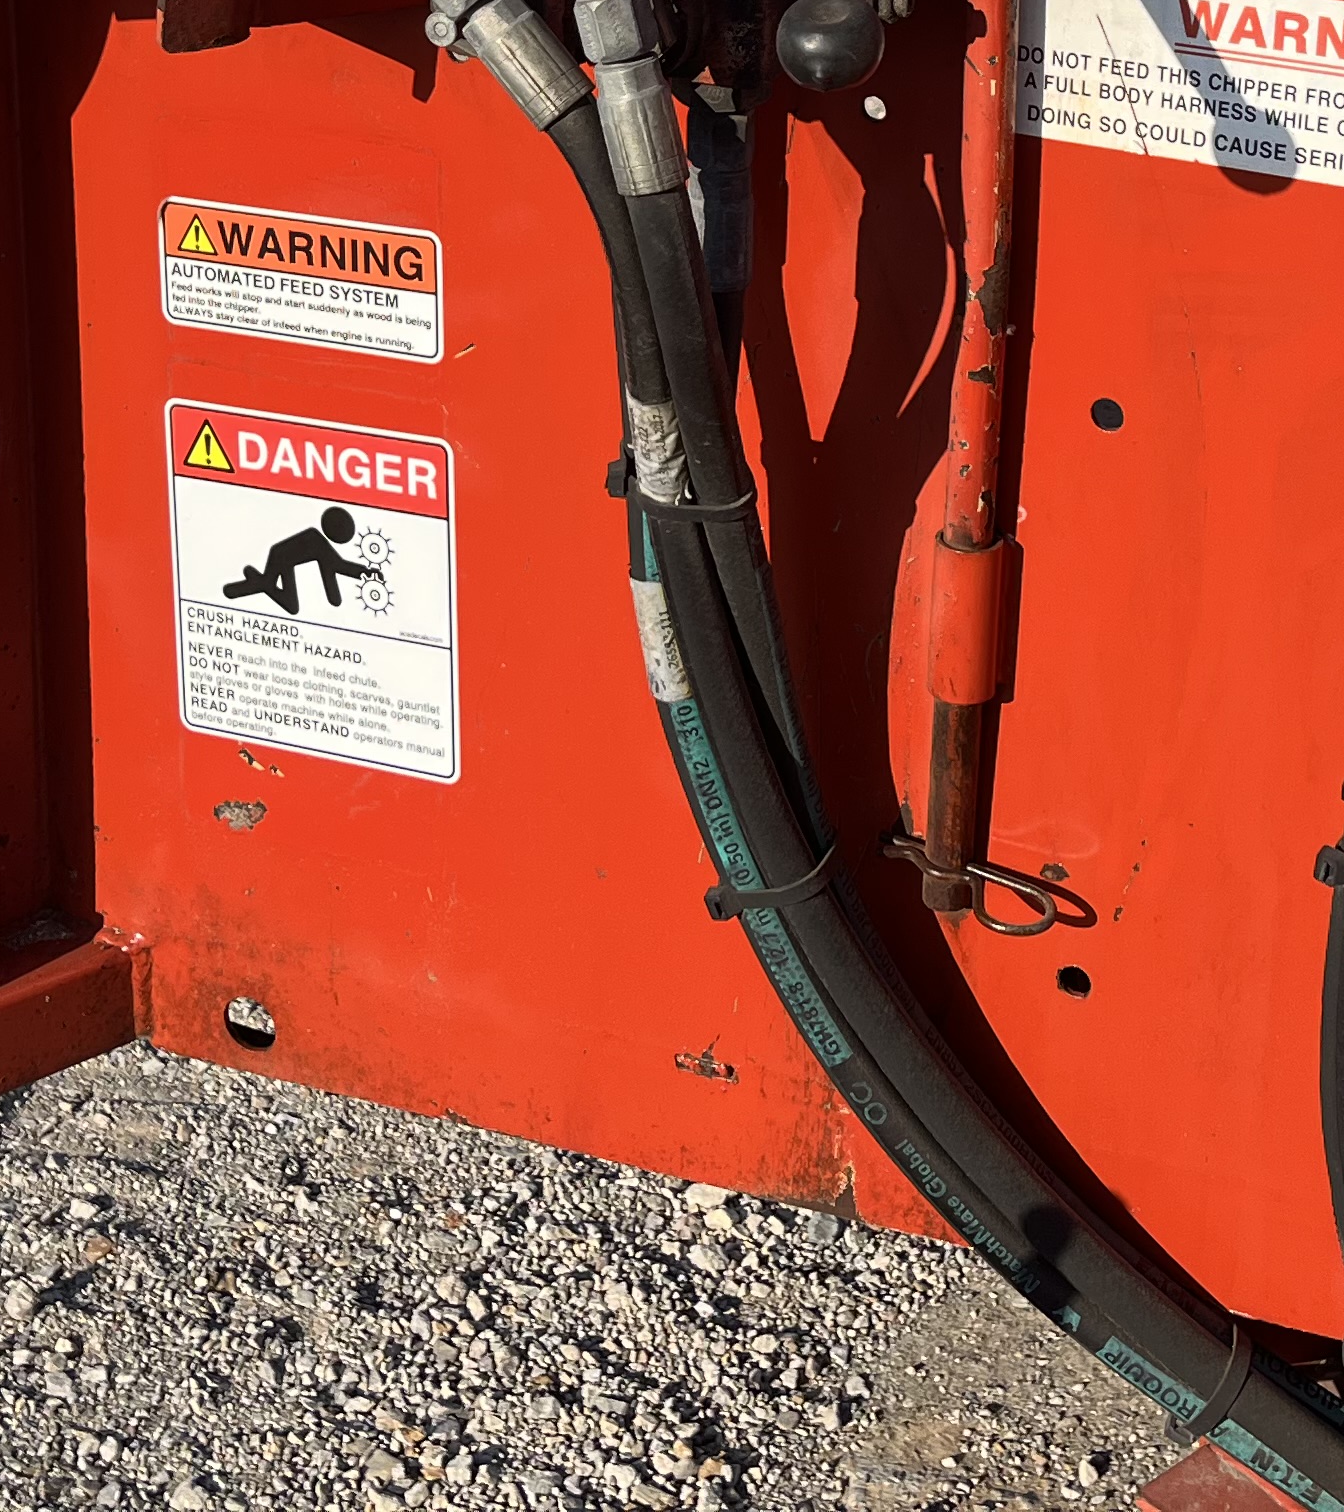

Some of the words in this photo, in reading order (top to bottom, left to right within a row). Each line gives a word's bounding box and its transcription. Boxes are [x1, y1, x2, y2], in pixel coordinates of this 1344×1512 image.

[1017, 43, 1045, 65] DO
[1052, 49, 1092, 72] NOT
[1099, 57, 1150, 81] FEED
[1157, 64, 1201, 88] THIS
[1207, 72, 1298, 104] CHIPPER
[1024, 72, 1037, 91] A
[1043, 74, 1092, 99] FULL
[1099, 81, 1154, 109] BODY
[1161, 91, 1257, 124] HARNESS
[1265, 109, 1329, 135] WHILE
[1026, 103, 1092, 130] DOING
[1098, 114, 1127, 136] SO
[1135, 120, 1207, 150] COULD
[1213, 132, 1287, 162] CAUSE
[217, 219, 424, 282] WARNING
[171, 262, 275, 290] AUTOMATED
[280, 278, 324, 297] FEED
[330, 286, 399, 308] SYSTEM
[171, 281, 193, 293] Feed
[195, 286, 222, 297] works
[224, 290, 240, 300] will
[242, 294, 262, 304] stop
[265, 296, 282, 306] and
[285, 299, 305, 309] start
[308, 302, 350, 319] suddenly
[366, 312, 392, 323] wood
[395, 314, 402, 323] is
[405, 316, 432, 330] being
[172, 293, 186, 303] fed
[188, 295, 206, 306] into
[208, 298, 222, 307] the
[172, 305, 213, 319] ALWAYS
[216, 312, 235, 324] stay
[237, 315, 259, 326] clear
[261, 318, 271, 327] of
[273, 320, 301, 332] infeed
[304, 324, 329, 336] when
[331, 328, 362, 342] engine
[365, 332, 372, 341] is
[238, 431, 438, 499] DANGER
[187, 607, 234, 626] CRUSH
[242, 617, 304, 639] HAZARD.
[188, 621, 300, 653] ENTANGLEMENT
[304, 642, 366, 665] HAZARD.
[189, 641, 234, 660] NEVER
[237, 651, 266, 667] reach
[269, 657, 288, 671] into
[290, 661, 307, 674] the
[313, 665, 345, 682] infeed
[189, 656, 208, 669] DO
[212, 660, 240, 676] NOT
[243, 668, 269, 682] wear
[272, 672, 300, 688] loose
[397, 696, 440, 716] gauntlet
[190, 669, 213, 685] style
[216, 673, 249, 692] gloves
[251, 680, 262, 690] or
[265, 683, 299, 701] gloves
[304, 689, 326, 704] with
[328, 694, 357, 710] holes
[360, 700, 387, 716] while
[190, 682, 235, 701] NEVER
[239, 691, 279, 711] operate
[281, 699, 325, 717] machine
[328, 708, 355, 723] while
[191, 710, 224, 726] before
[191, 696, 228, 714] READ
[231, 705, 251, 718] and
[254, 708, 349, 739] UNDERSTAND
[353, 726, 404, 749] operators
[406, 737, 445, 759] manual
[692, 759, 723, 808] DN12
[894, 1139, 948, 1199] Global
[947, 1195, 1041, 1294] MatchMate
